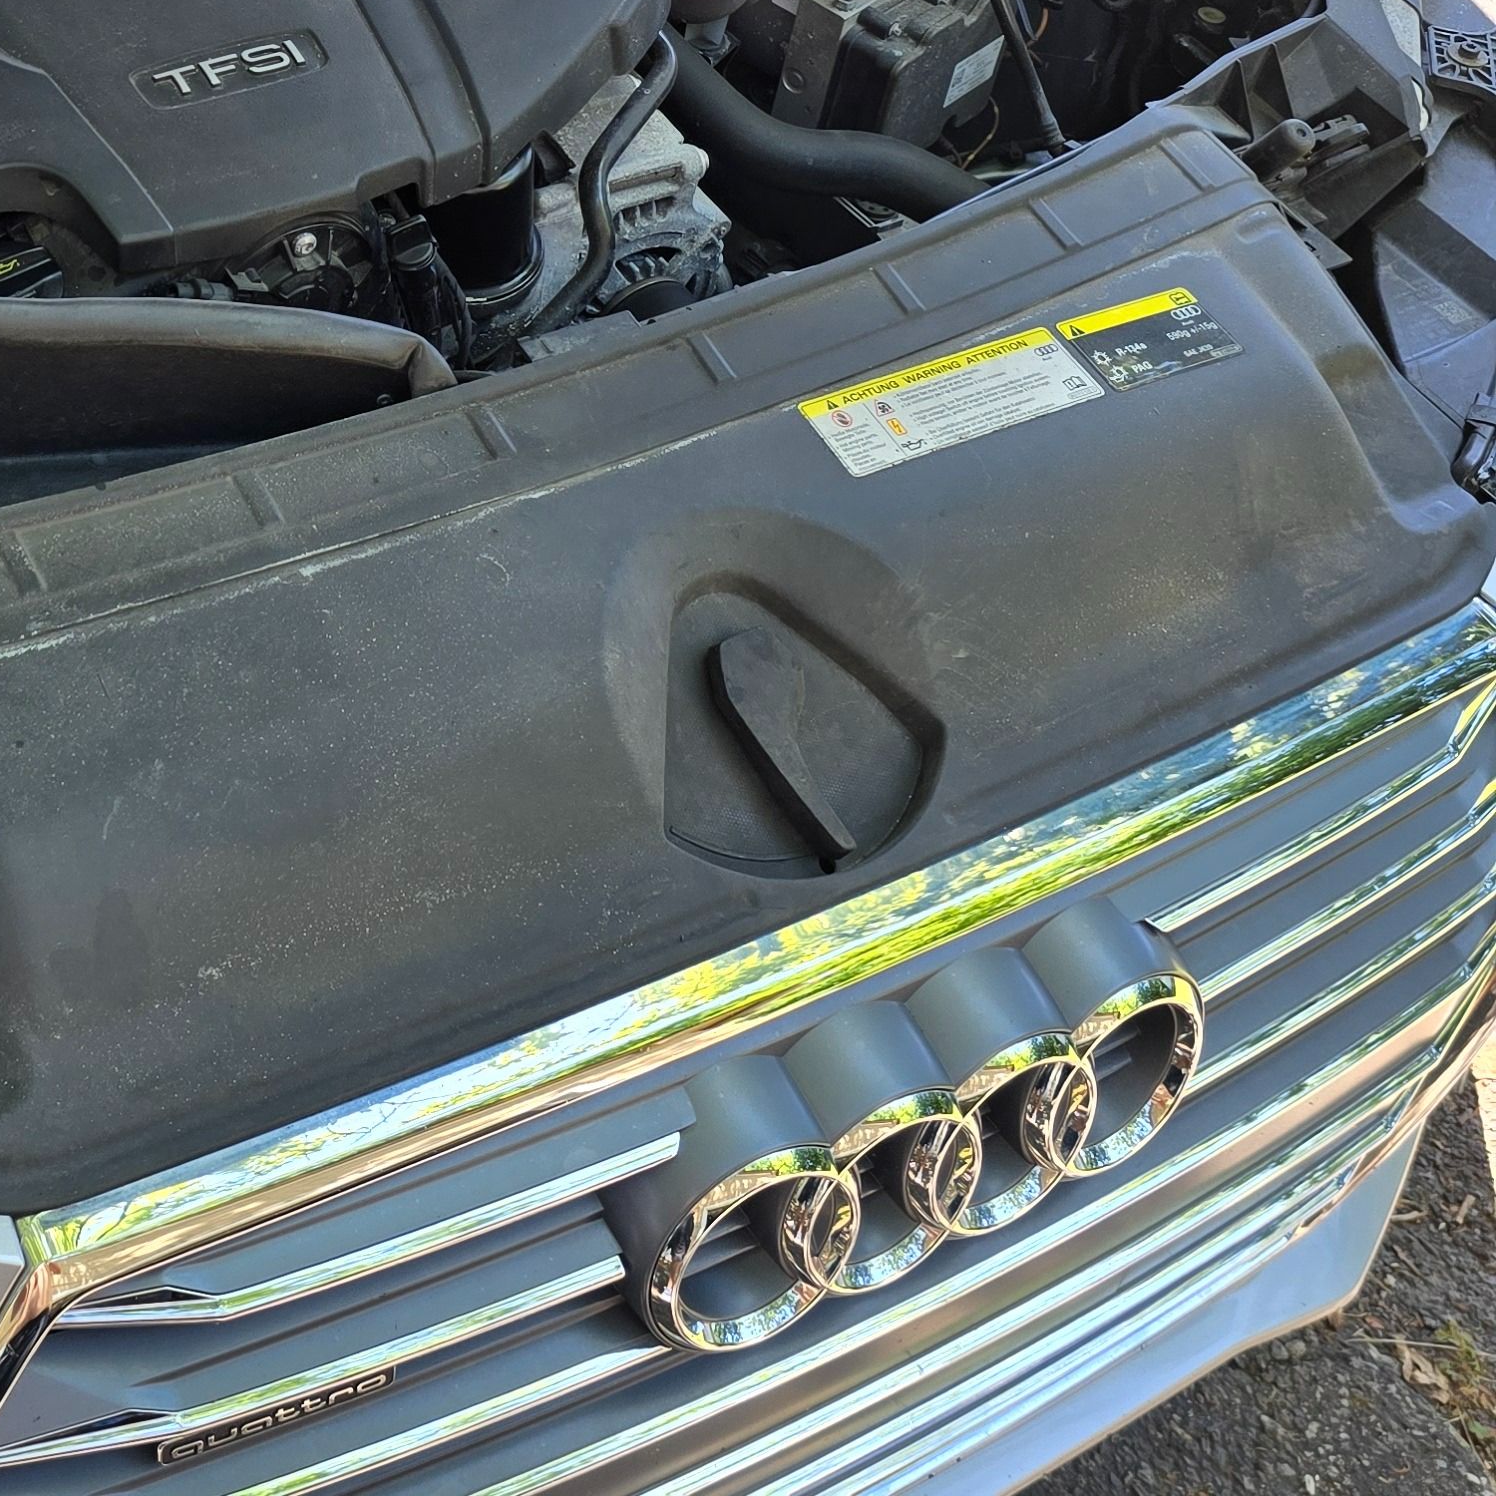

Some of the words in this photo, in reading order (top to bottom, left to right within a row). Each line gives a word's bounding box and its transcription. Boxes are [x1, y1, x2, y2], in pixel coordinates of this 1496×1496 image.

[152, 39, 306, 94] TFSI
[842, 379, 899, 405] ACHTUNG
[903, 360, 961, 390] WARNING
[966, 339, 1029, 365] ATTENTION
[172, 1373, 387, 1460] quattro
